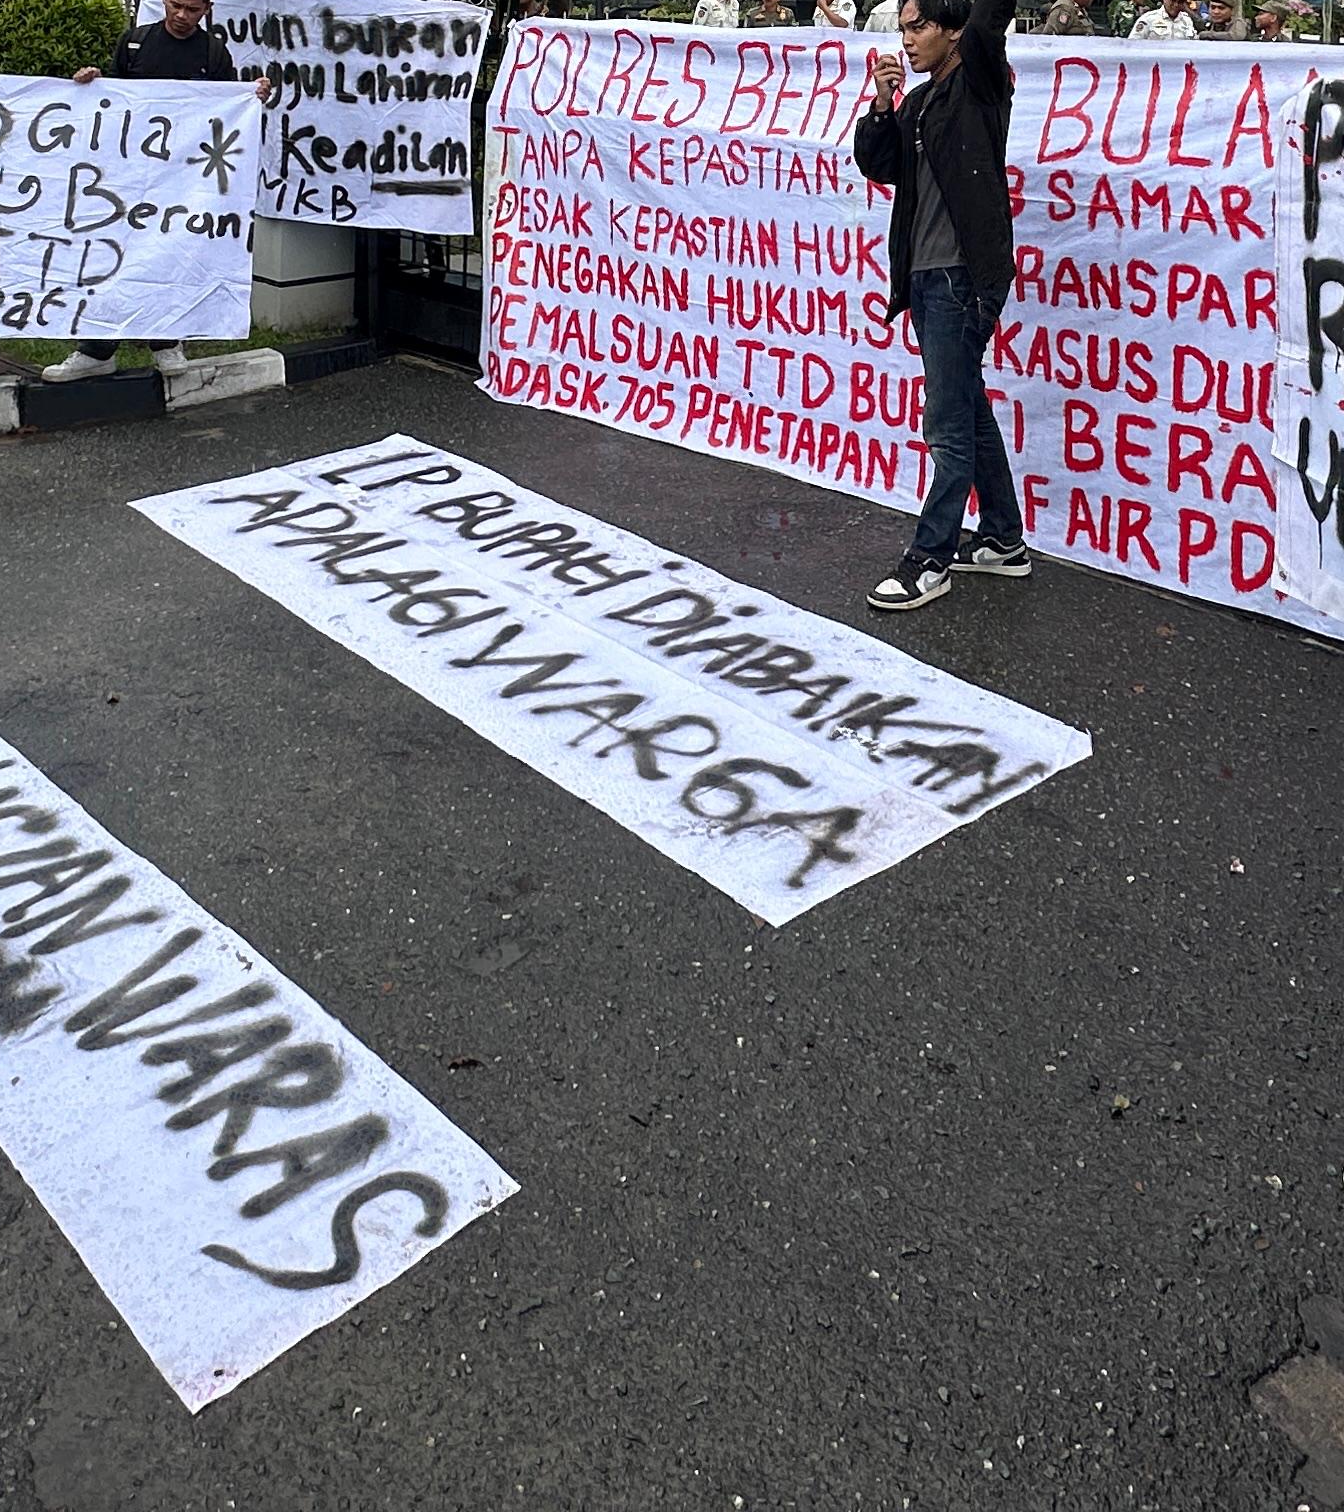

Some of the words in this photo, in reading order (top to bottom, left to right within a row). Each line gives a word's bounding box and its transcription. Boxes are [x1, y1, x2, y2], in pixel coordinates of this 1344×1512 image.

[499, 27, 716, 123] POLRES
[492, 125, 604, 181] TANPA
[1047, 169, 1276, 241] SAMAR
[494, 182, 594, 237] DESAK
[609, 198, 781, 268] KEPASTIAN
[794, 220, 888, 283] HUK
[491, 232, 690, 312] PENEGAKAN
[994, 320, 1158, 404] KASUS
[1016, 244, 1278, 334] RANSPAR
[681, 383, 899, 492] PENETAPAN
[736, 339, 836, 410] TTD
[1063, 398, 1278, 512] BERA
[63, 925, 452, 1291] WARAS
